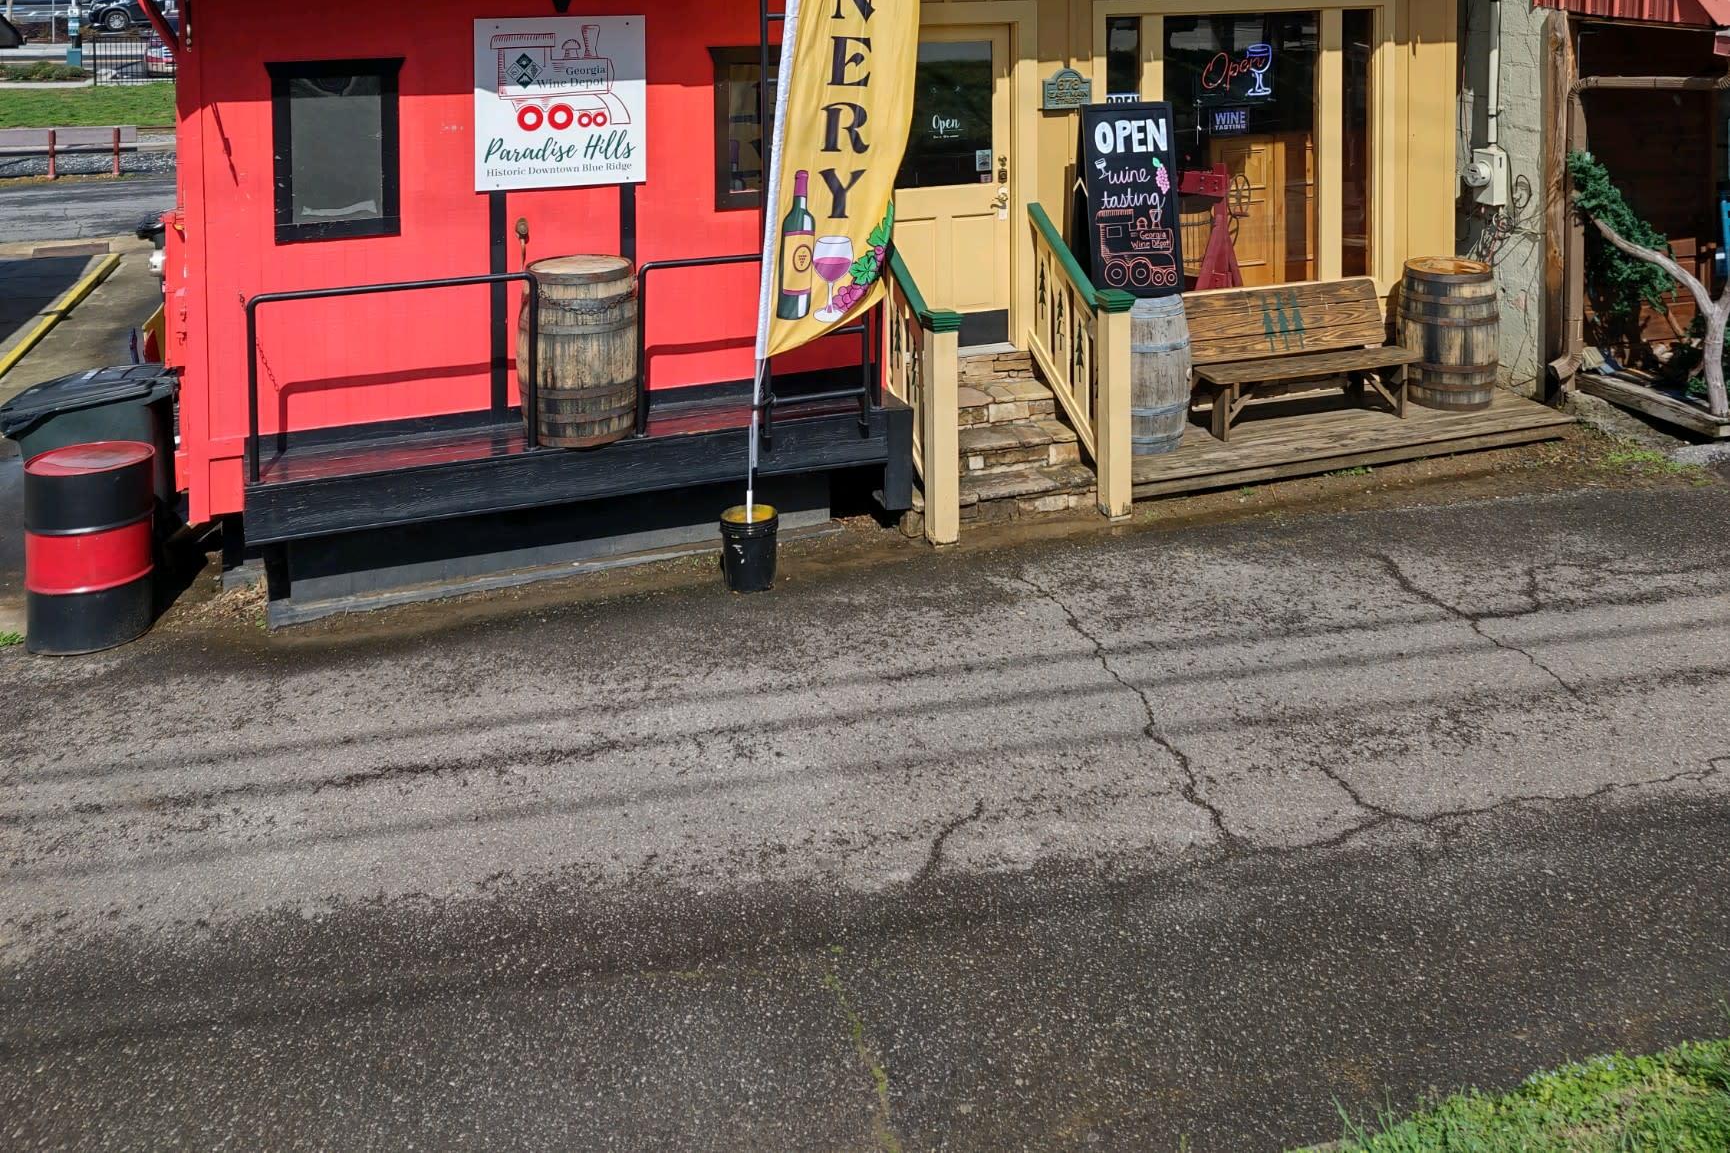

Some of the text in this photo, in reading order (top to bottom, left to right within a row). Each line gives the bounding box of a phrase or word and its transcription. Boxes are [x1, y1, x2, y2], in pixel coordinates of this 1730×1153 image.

[565, 65, 606, 76] Georgia
[1202, 52, 1266, 91] Open
[536, 77, 603, 89] Wine Depot
[932, 114, 960, 134] Open
[1215, 111, 1246, 125] WINE
[1094, 118, 1168, 154] OPEN
[484, 129, 636, 164] Paradise Hills
[486, 161, 632, 177] Historic Downtown Blue Ridge
[1107, 166, 1151, 185] wine
[1101, 187, 1166, 223] tasting
[1140, 230, 1167, 240] Georgia
[1130, 240, 1150, 248] Wine
